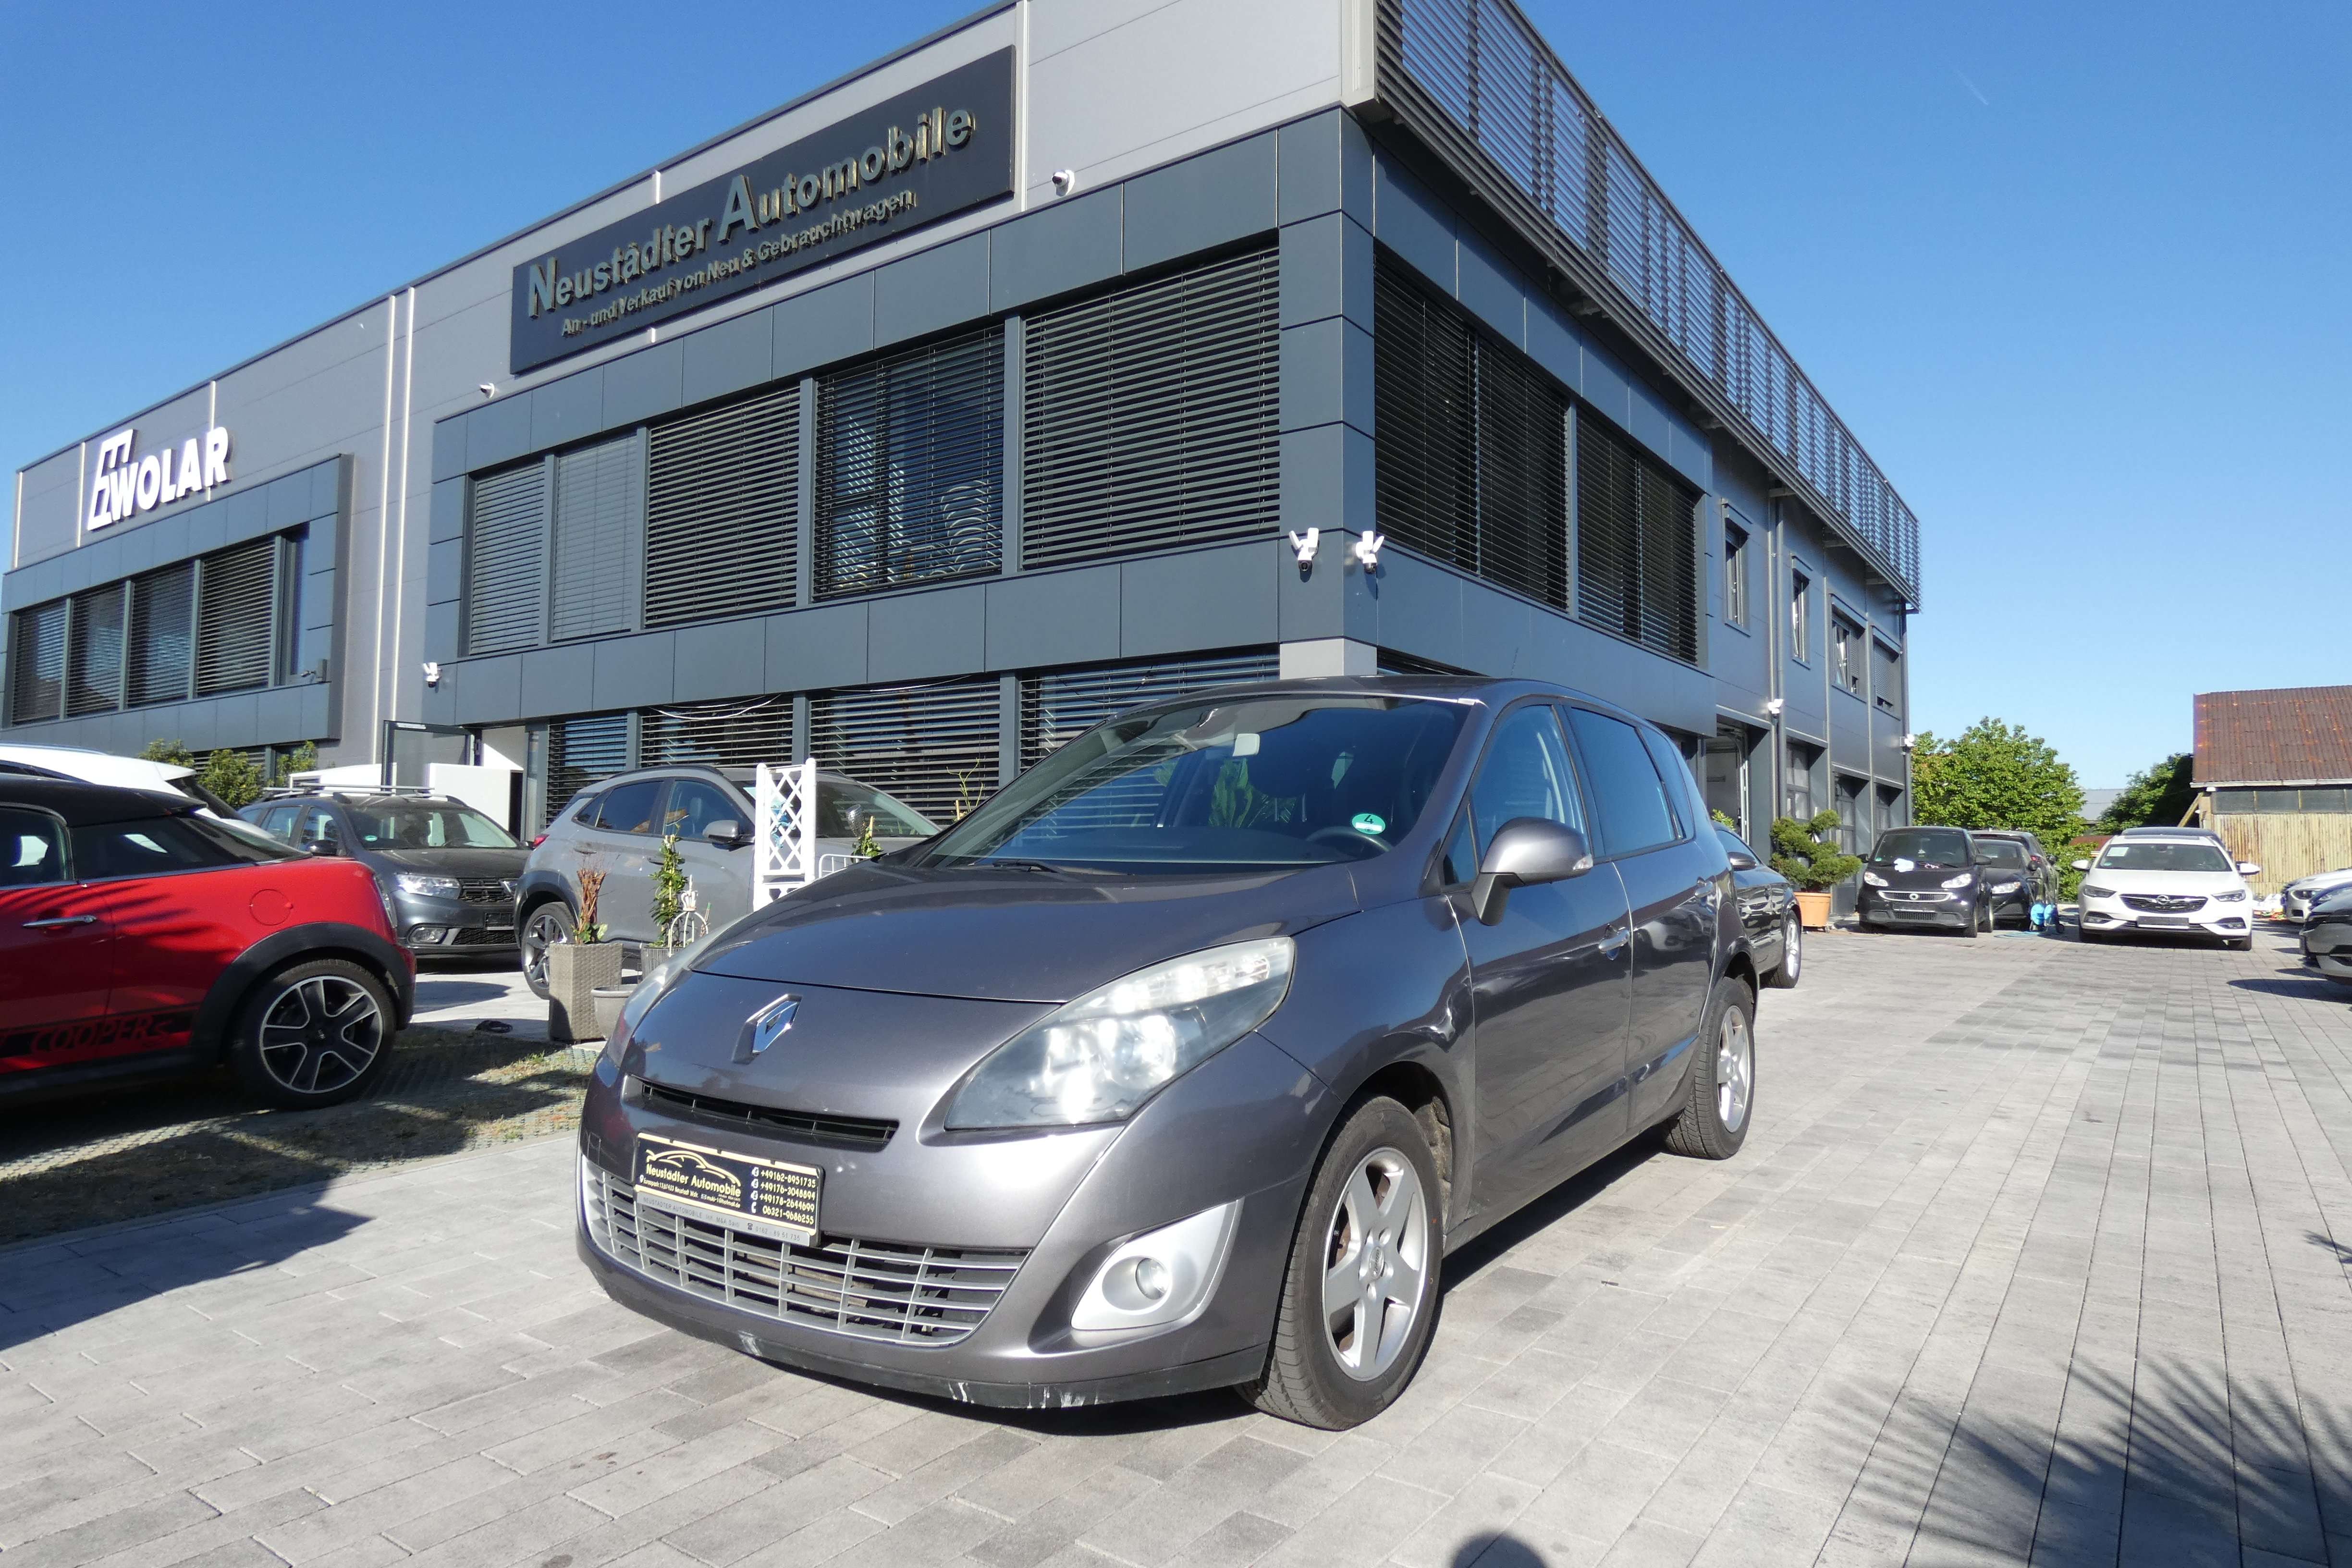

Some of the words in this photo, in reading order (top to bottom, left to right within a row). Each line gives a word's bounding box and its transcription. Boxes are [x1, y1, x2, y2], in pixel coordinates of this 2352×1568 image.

[529, 217, 710, 319] Neustädter
[717, 107, 975, 243] Automobile
[591, 300, 618, 326] und
[618, 280, 675, 314] Verkauf
[675, 270, 707, 292] von
[707, 259, 741, 282] Neu
[742, 248, 757, 269] &
[758, 189, 917, 262] Gebrauchtwagen
[1364, 815, 1374, 824] 4
[646, 1164, 689, 1184] Neustädter
[691, 1175, 741, 1197] Automobile
[760, 1170, 816, 1188] +49162-8951735
[760, 1182, 815, 1200] +49176-3048894
[760, 1193, 815, 1212] +49178-2644699
[762, 1205, 814, 1225] 06321-9686255
